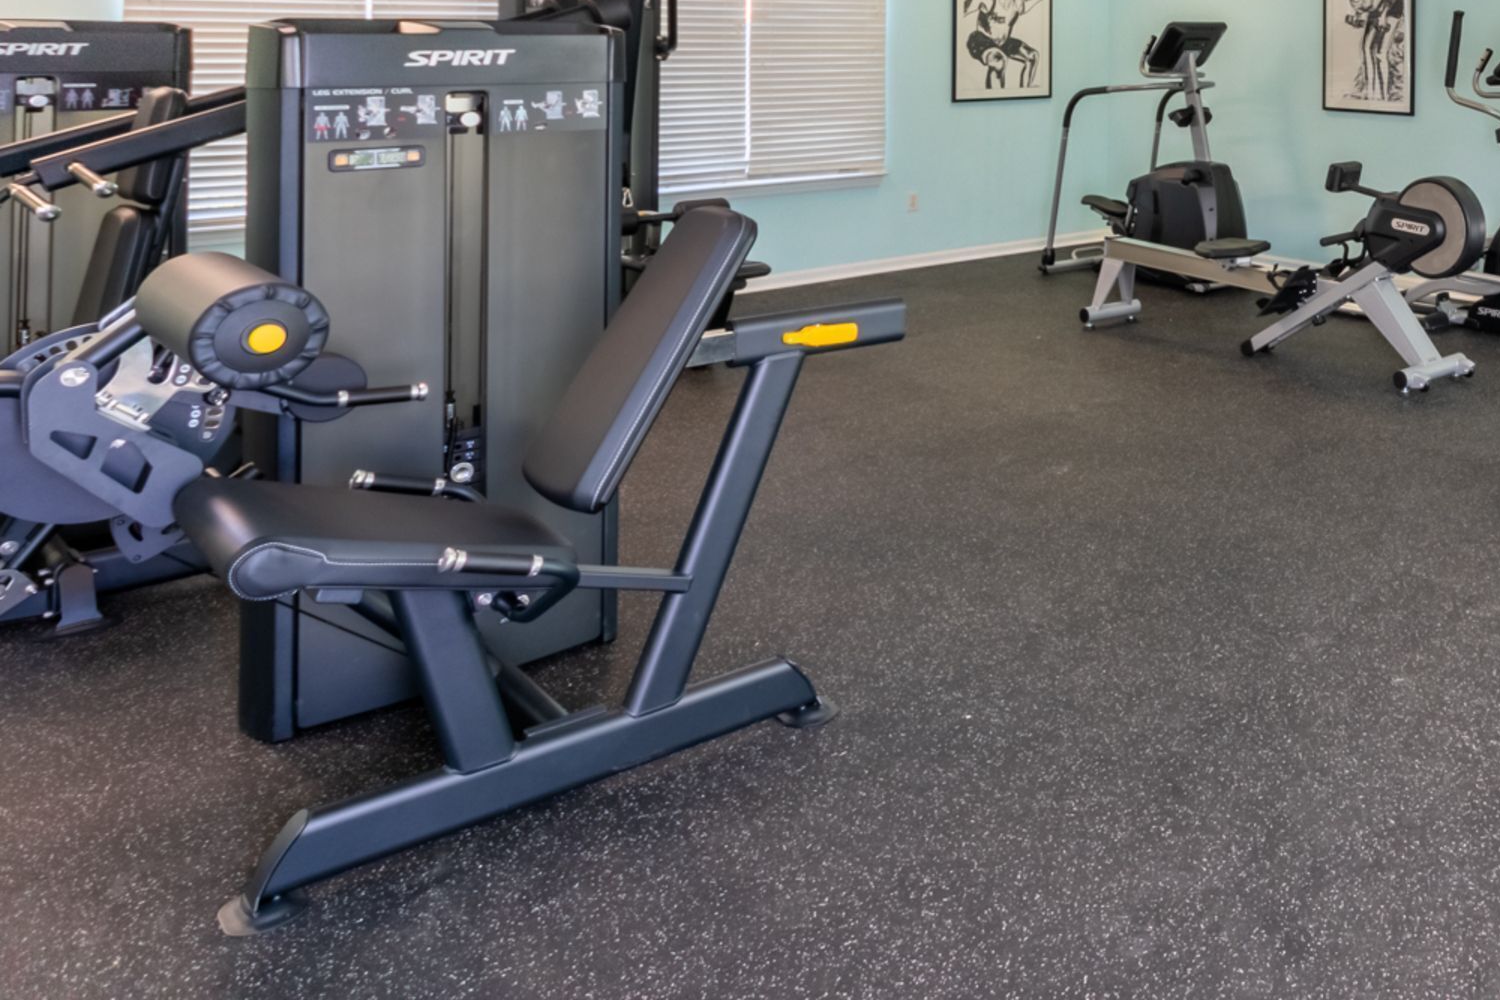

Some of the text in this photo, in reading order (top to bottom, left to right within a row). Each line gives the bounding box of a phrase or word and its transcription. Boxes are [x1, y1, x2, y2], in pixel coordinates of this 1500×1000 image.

[403, 48, 516, 67] SPIRIT
[332, 87, 383, 96] EXTENSION
[391, 86, 414, 95] CURL
[1395, 220, 1426, 233] SPIRIT
